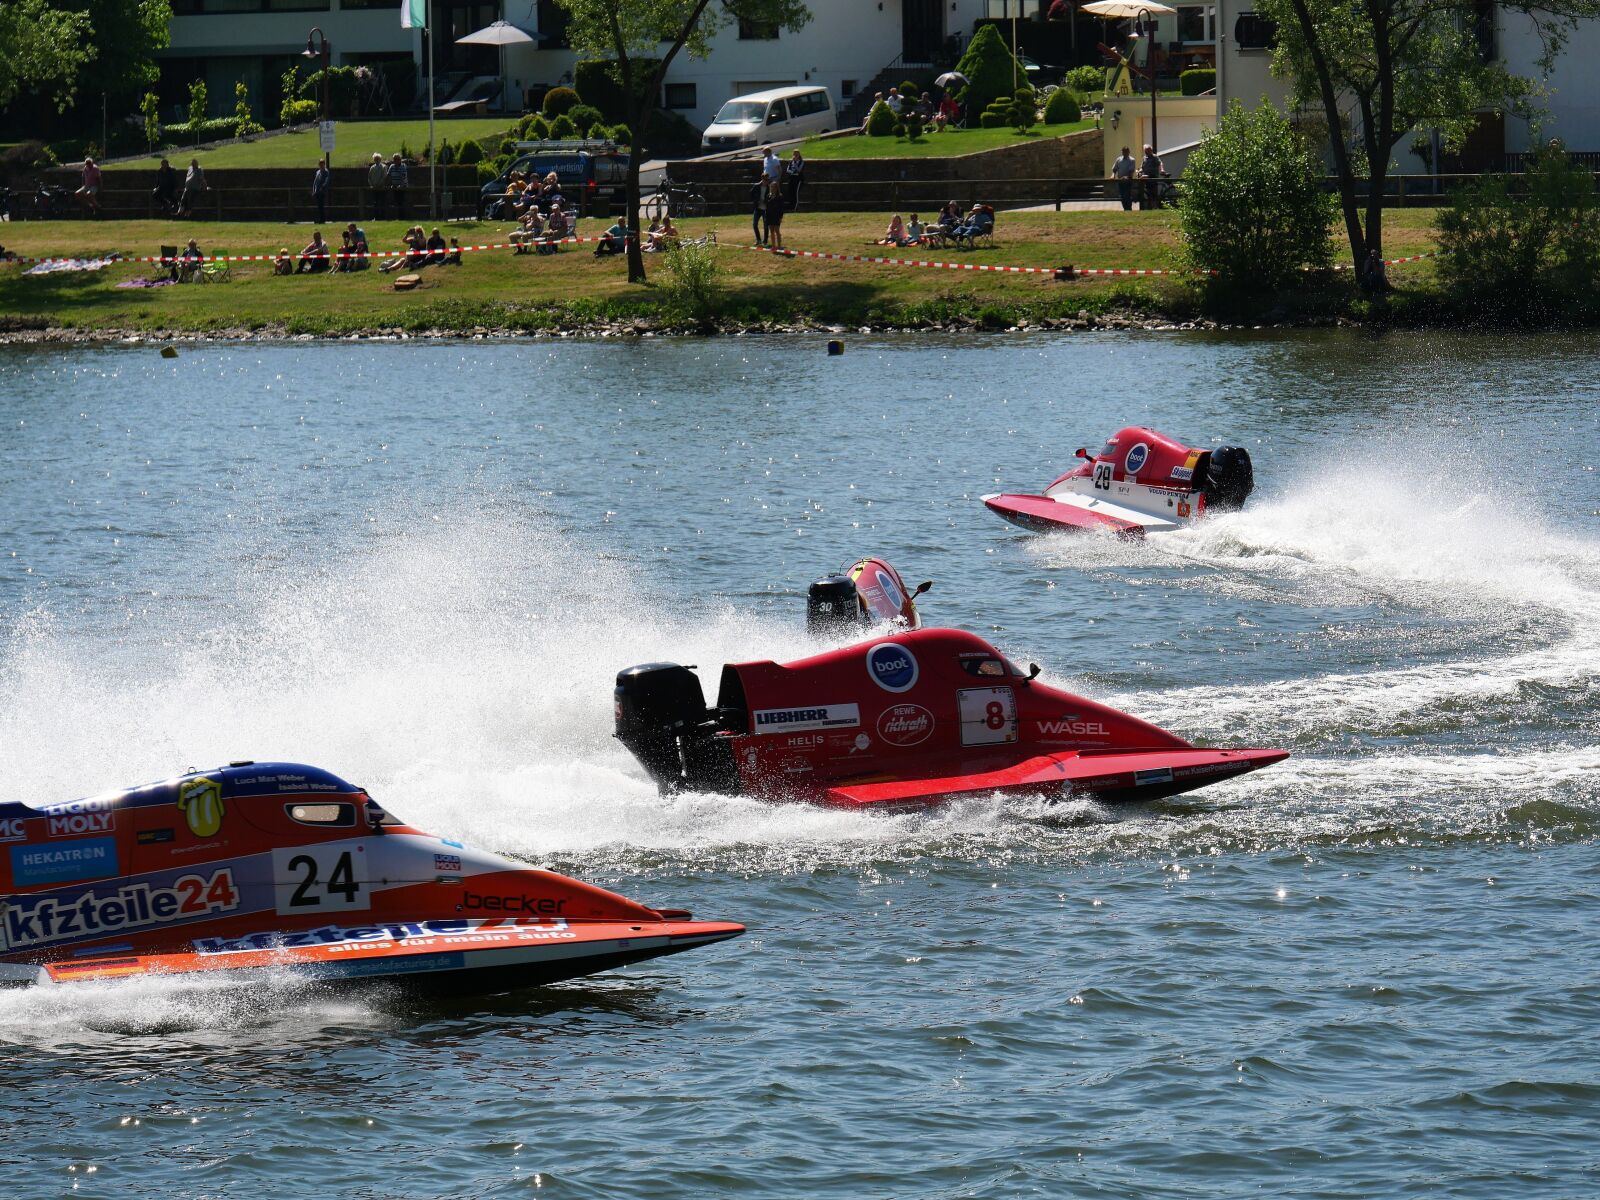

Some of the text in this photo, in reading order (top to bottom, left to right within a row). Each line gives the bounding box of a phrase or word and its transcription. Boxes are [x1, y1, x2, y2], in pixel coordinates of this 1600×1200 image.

[1129, 453, 1144, 463] boot
[1148, 487, 1167, 496] VOLVO
[819, 601, 833, 611] 30
[874, 657, 908, 672] boot
[756, 708, 828, 725] LIEBHERR
[894, 705, 916, 716] REWE
[986, 701, 1005, 730] 8
[1036, 720, 1111, 736] WASEL
[278, 774, 305, 782] Weber
[49, 813, 112, 834] MOLY
[22, 846, 105, 866] HEKATRON
[288, 851, 359, 906] 24
[9, 873, 235, 942] kfzteile24
[463, 891, 566, 915] becker
[327, 930, 577, 953] alles für mein auto
